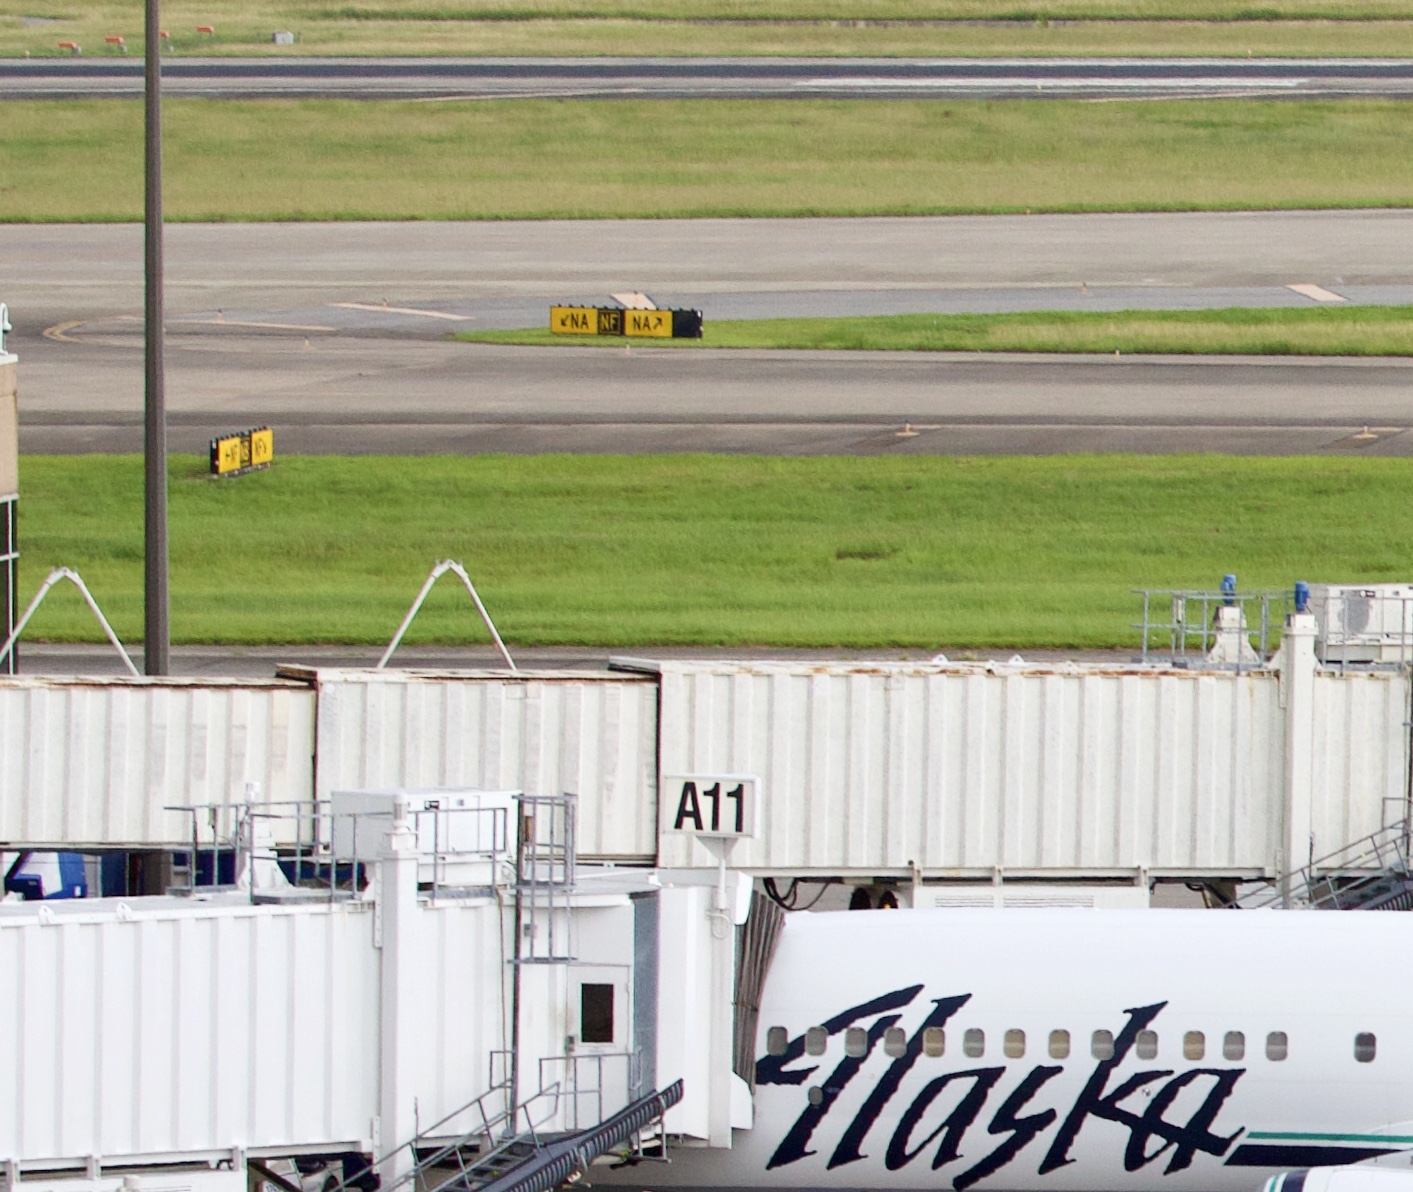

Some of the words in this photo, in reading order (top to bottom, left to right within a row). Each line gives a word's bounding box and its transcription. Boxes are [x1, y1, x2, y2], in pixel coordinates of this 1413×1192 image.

[571, 312, 589, 329] NA
[600, 312, 619, 332] NF
[633, 315, 651, 331] NA
[673, 781, 744, 833] A11
[755, 984, 1247, 1192] Alaska
